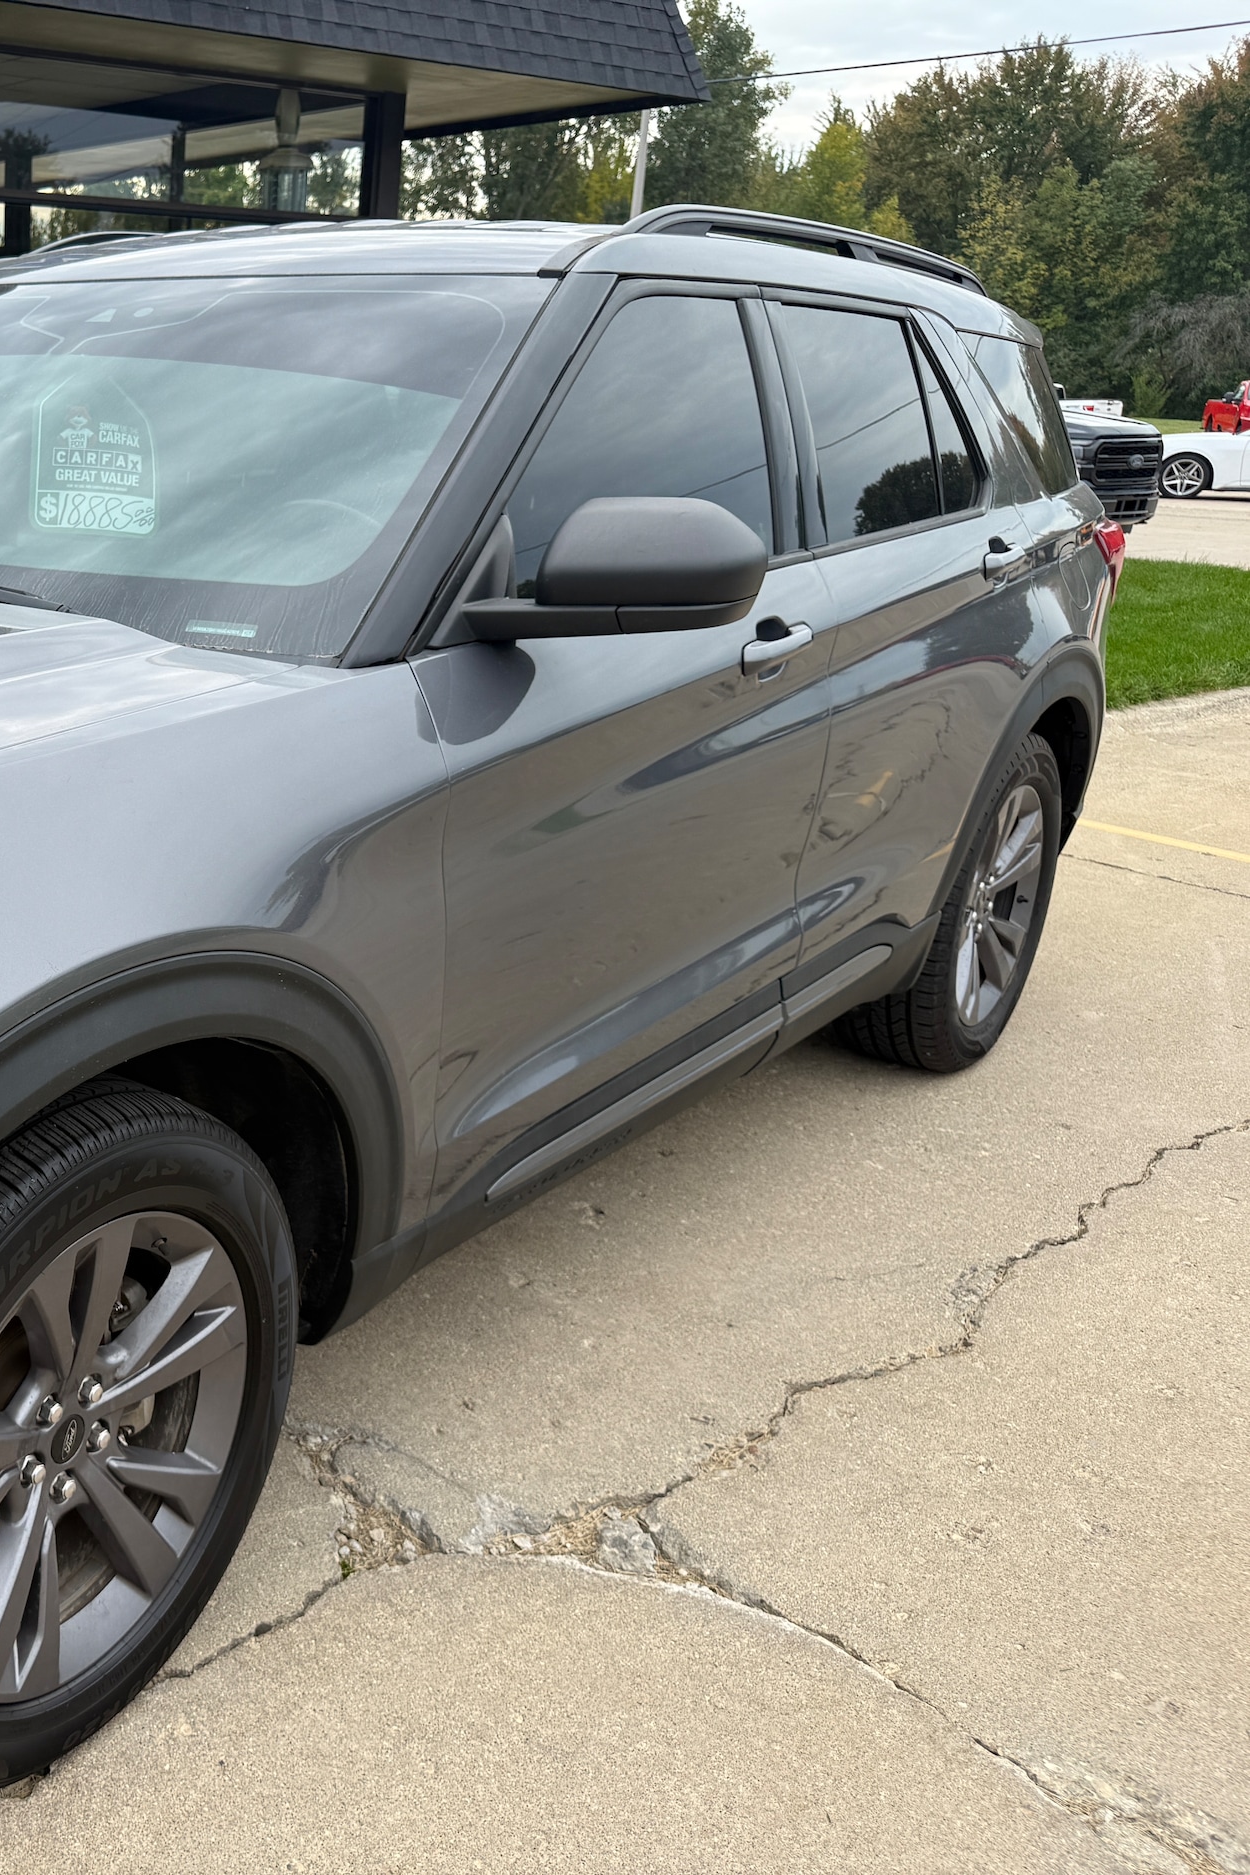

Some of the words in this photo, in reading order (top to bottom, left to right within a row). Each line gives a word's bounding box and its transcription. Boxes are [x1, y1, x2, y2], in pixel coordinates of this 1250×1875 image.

[70, 433, 86, 441] CAR
[98, 430, 141, 449] CARFAX
[55, 450, 141, 472] CARFAX
[55, 468, 98, 482] GREAT
[100, 471, 140, 487] VALUE
[134, 1157, 183, 1183] AS
[63, 1427, 75, 1453] Ford
